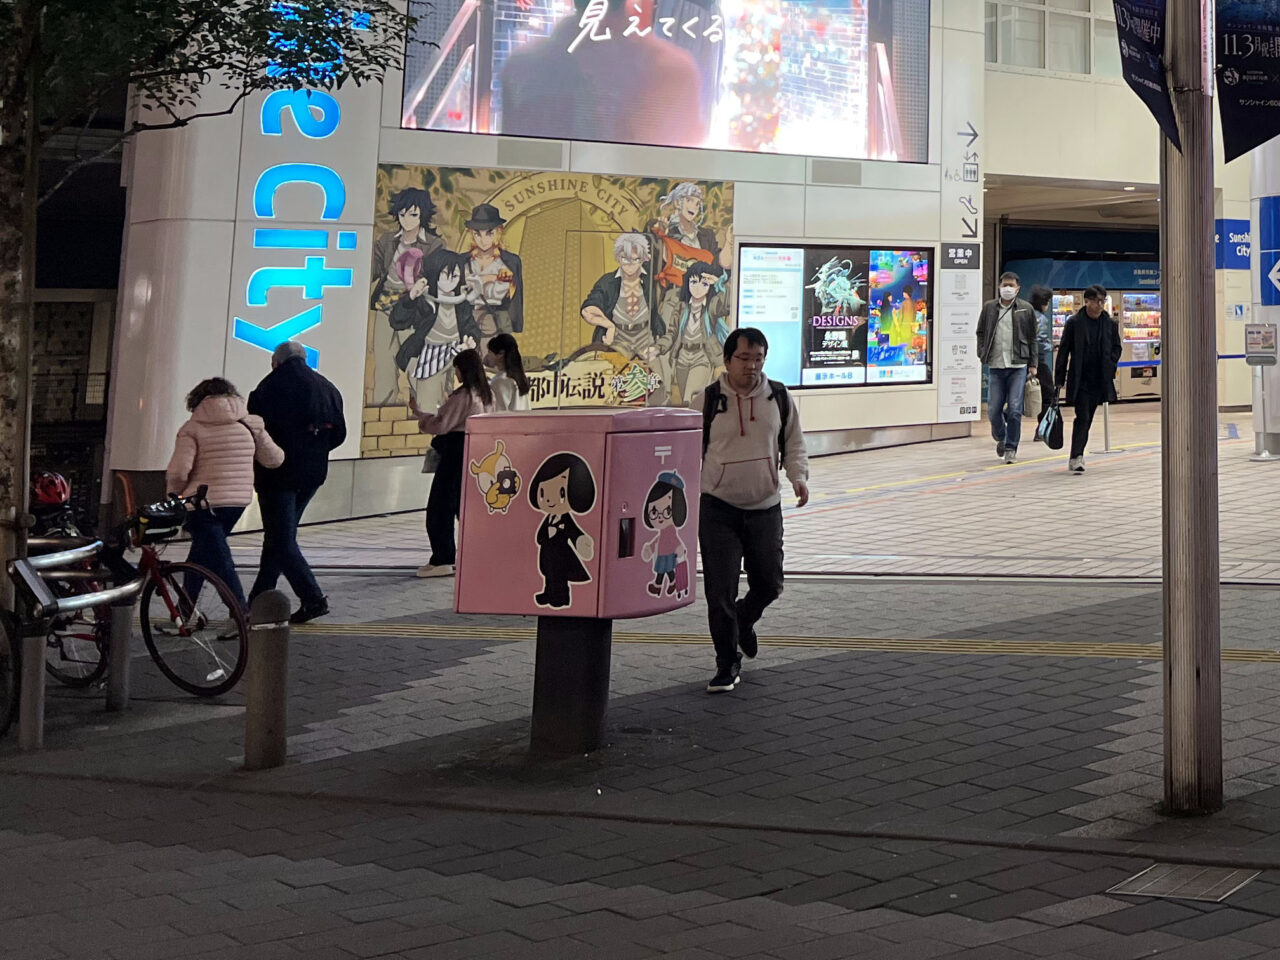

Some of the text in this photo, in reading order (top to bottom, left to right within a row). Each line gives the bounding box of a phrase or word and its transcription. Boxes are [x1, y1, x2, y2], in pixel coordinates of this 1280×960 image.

[504, 178, 629, 216] SUNSHINE CITY
[1229, 232, 1250, 243] Sunshi
[949, 248, 973, 259] 営業中
[812, 315, 859, 327] DESIGNS
